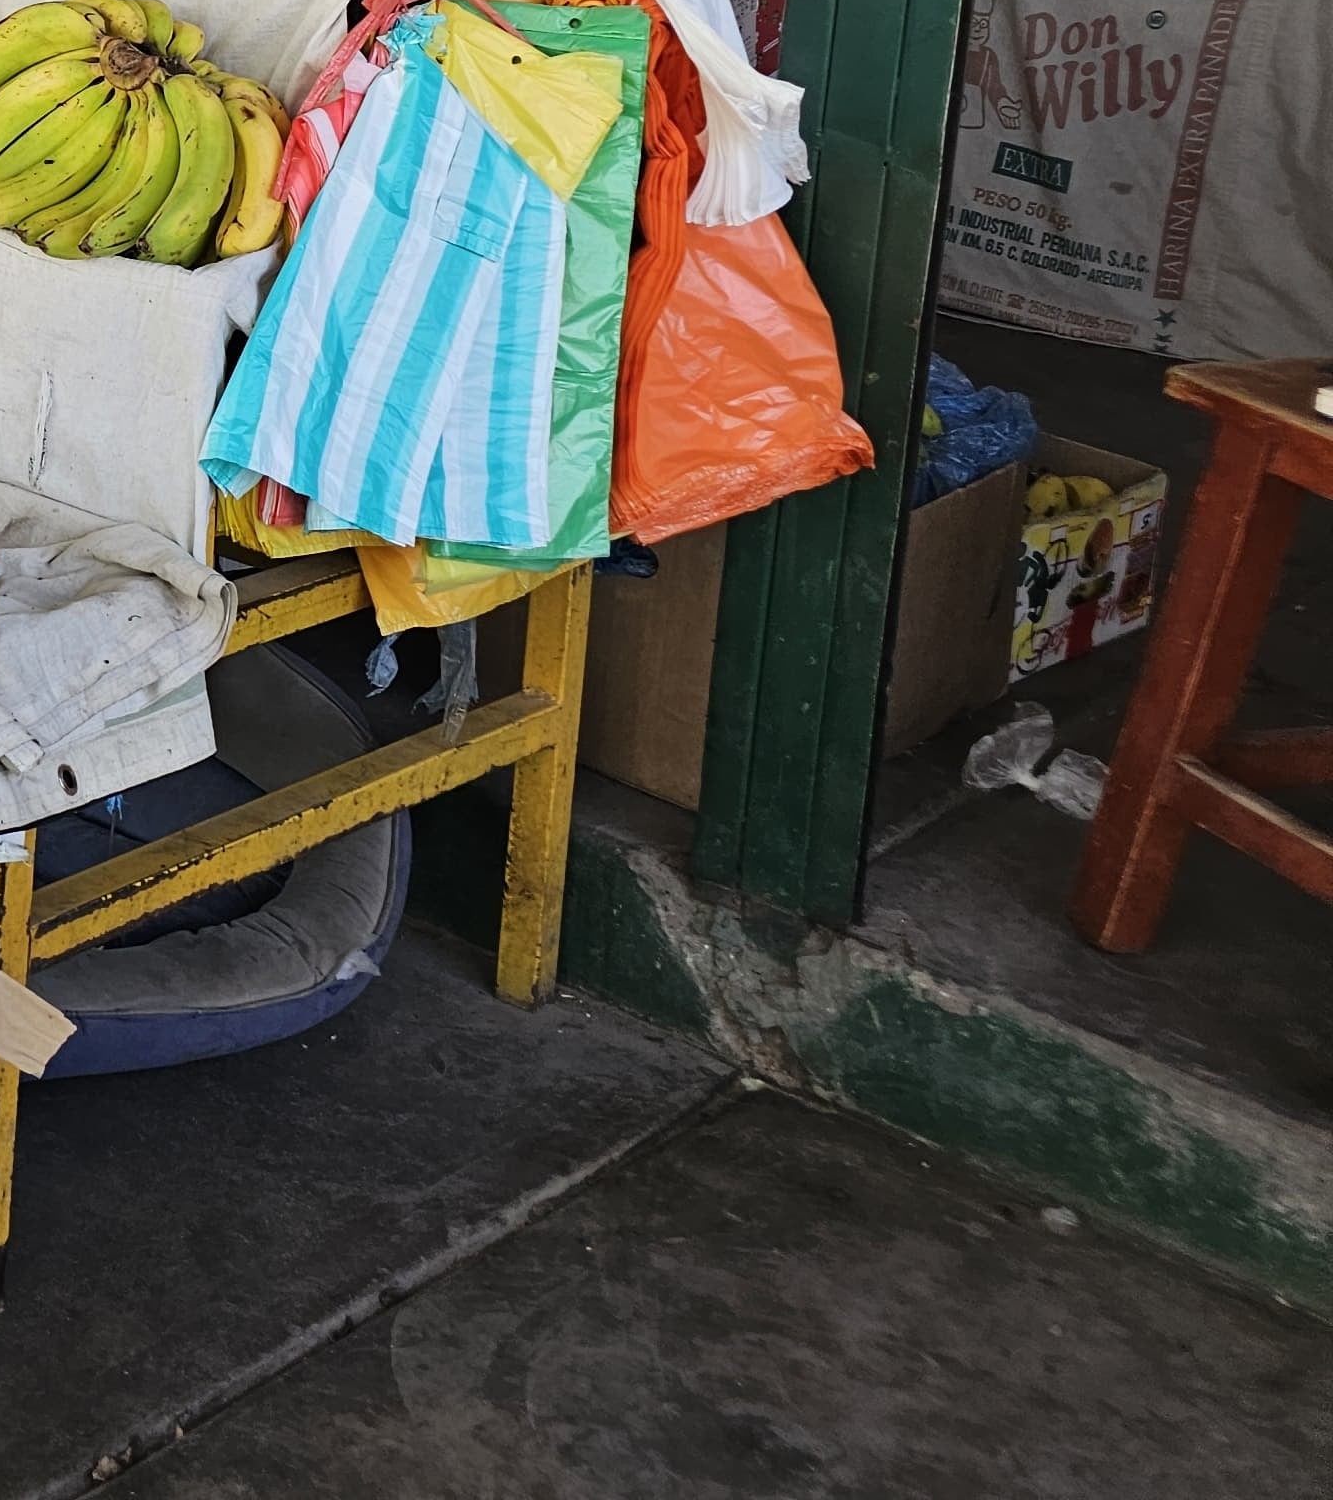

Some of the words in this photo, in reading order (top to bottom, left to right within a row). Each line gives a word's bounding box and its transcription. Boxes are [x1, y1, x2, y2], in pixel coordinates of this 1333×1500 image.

[1024, 11, 1120, 61] Don
[1023, 43, 1184, 133] Willy
[1000, 146, 1063, 188] EXTRA
[1176, 110, 1213, 190] EXTRA
[972, 186, 1021, 212] PESO
[1024, 201, 1047, 220] 50
[959, 208, 1035, 246] INDUSTRIAL
[1040, 231, 1102, 264] PERUANA
[1106, 250, 1150, 274] S.A.C.
[1158, 196, 1196, 296] HARINA
